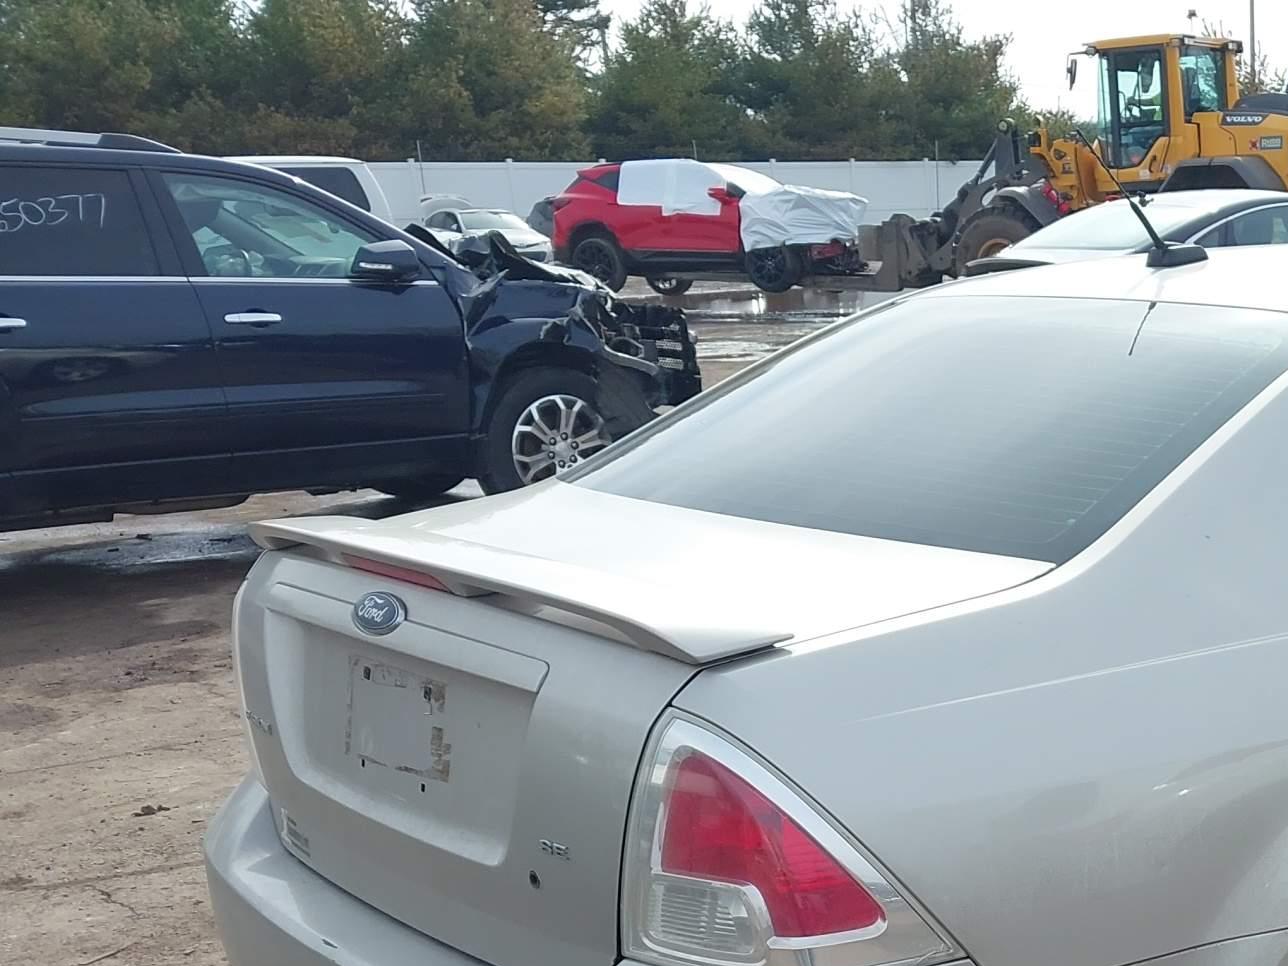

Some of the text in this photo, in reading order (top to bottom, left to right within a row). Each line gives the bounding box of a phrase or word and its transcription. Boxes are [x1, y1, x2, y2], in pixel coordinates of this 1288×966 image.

[1225, 115, 1263, 123] VOLVO
[358, 595, 389, 622] Ford
[539, 839, 568, 857] SE
